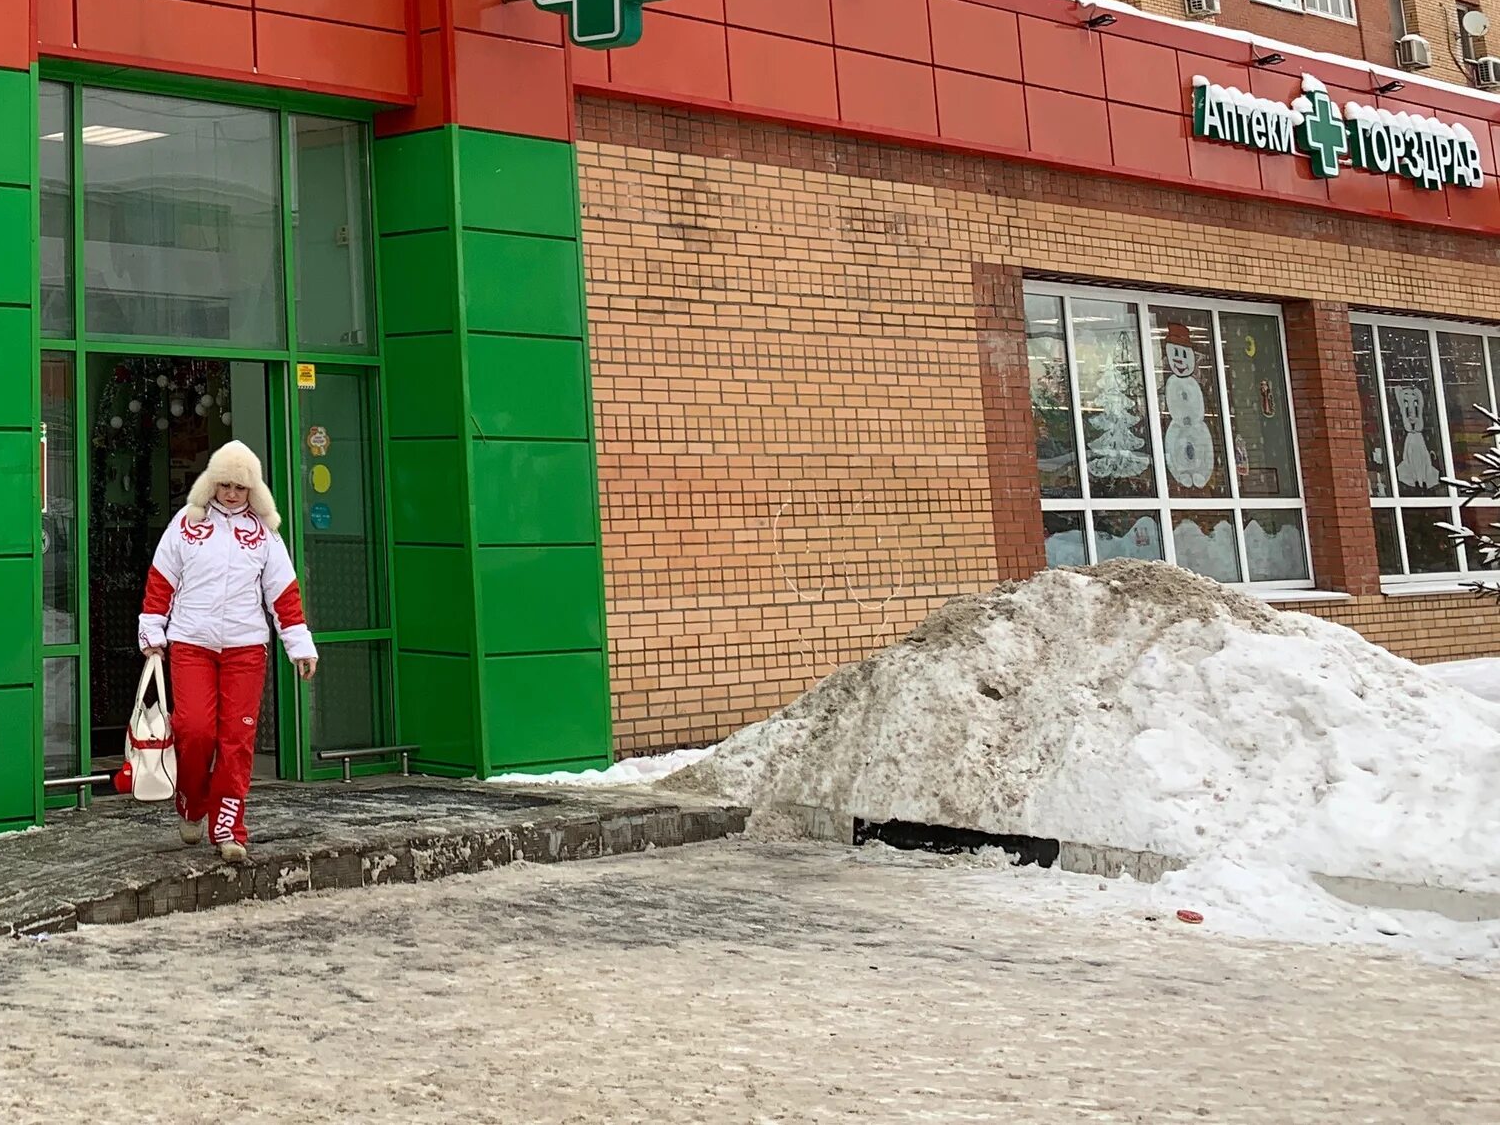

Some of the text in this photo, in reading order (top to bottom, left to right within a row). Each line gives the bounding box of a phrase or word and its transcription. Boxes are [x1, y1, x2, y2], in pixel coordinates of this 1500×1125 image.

[1203, 84, 1485, 191] Аптеки ГОРЗДРАВ
[213, 797, 241, 843] USSIA
